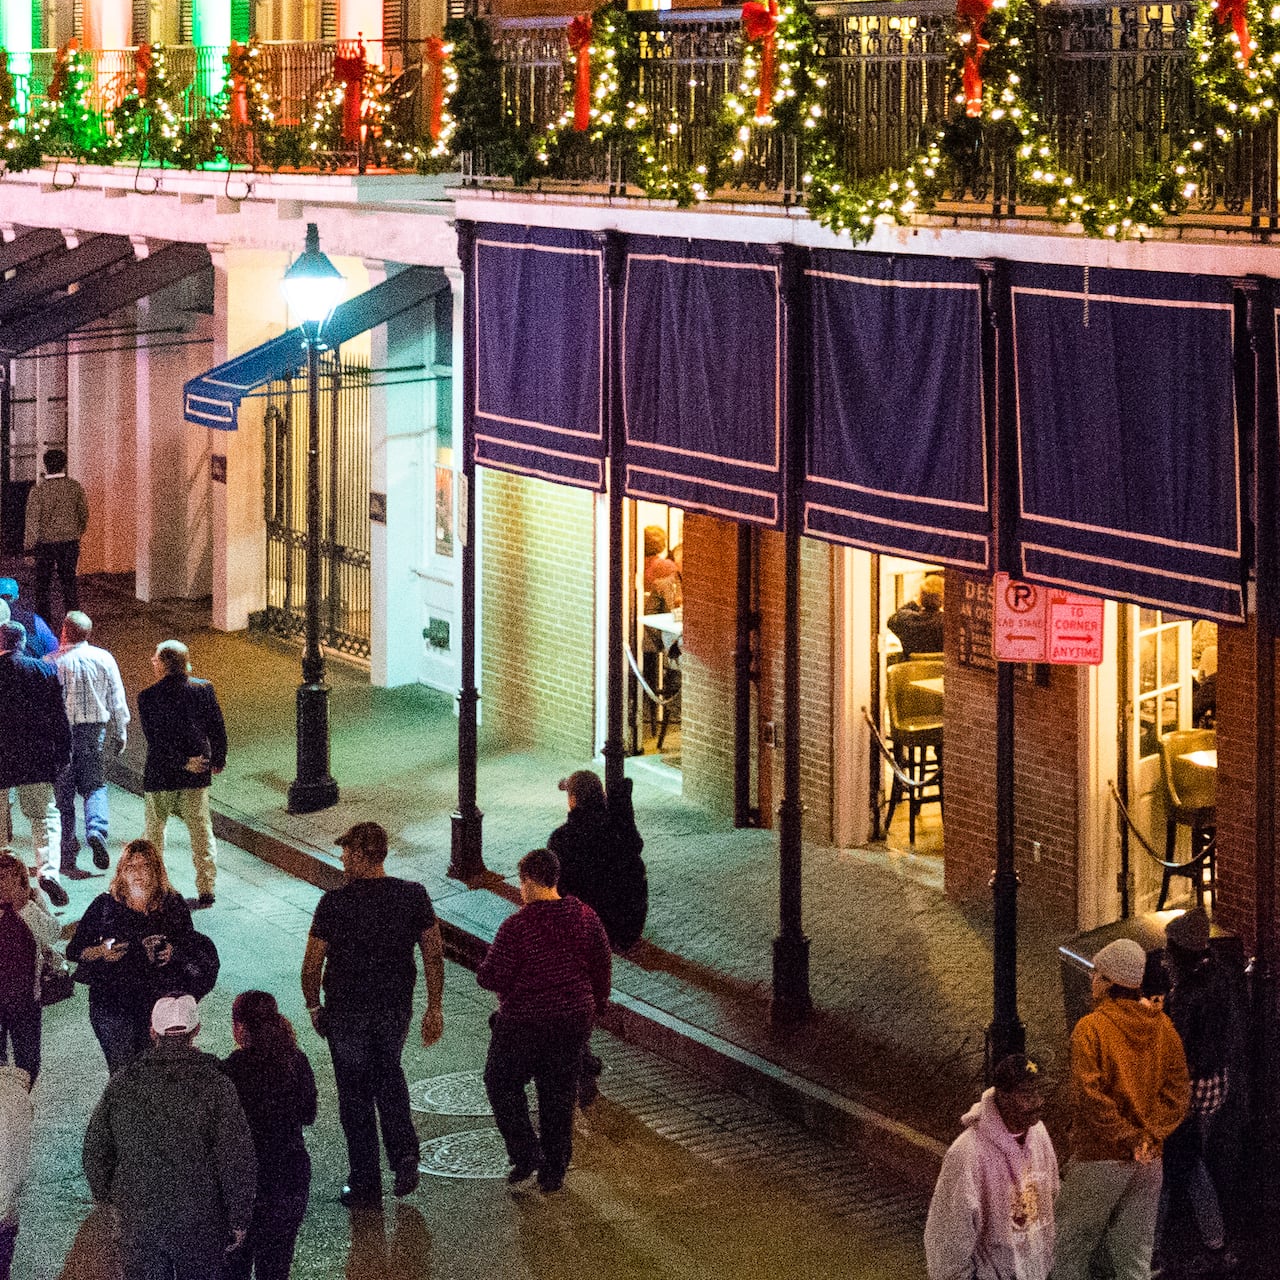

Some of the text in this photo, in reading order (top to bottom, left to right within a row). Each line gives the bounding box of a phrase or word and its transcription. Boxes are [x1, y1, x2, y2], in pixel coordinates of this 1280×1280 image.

[1071, 607, 1084, 617] TO
[1055, 619, 1098, 631] CORNER
[1053, 647, 1099, 658] ANYTIME
